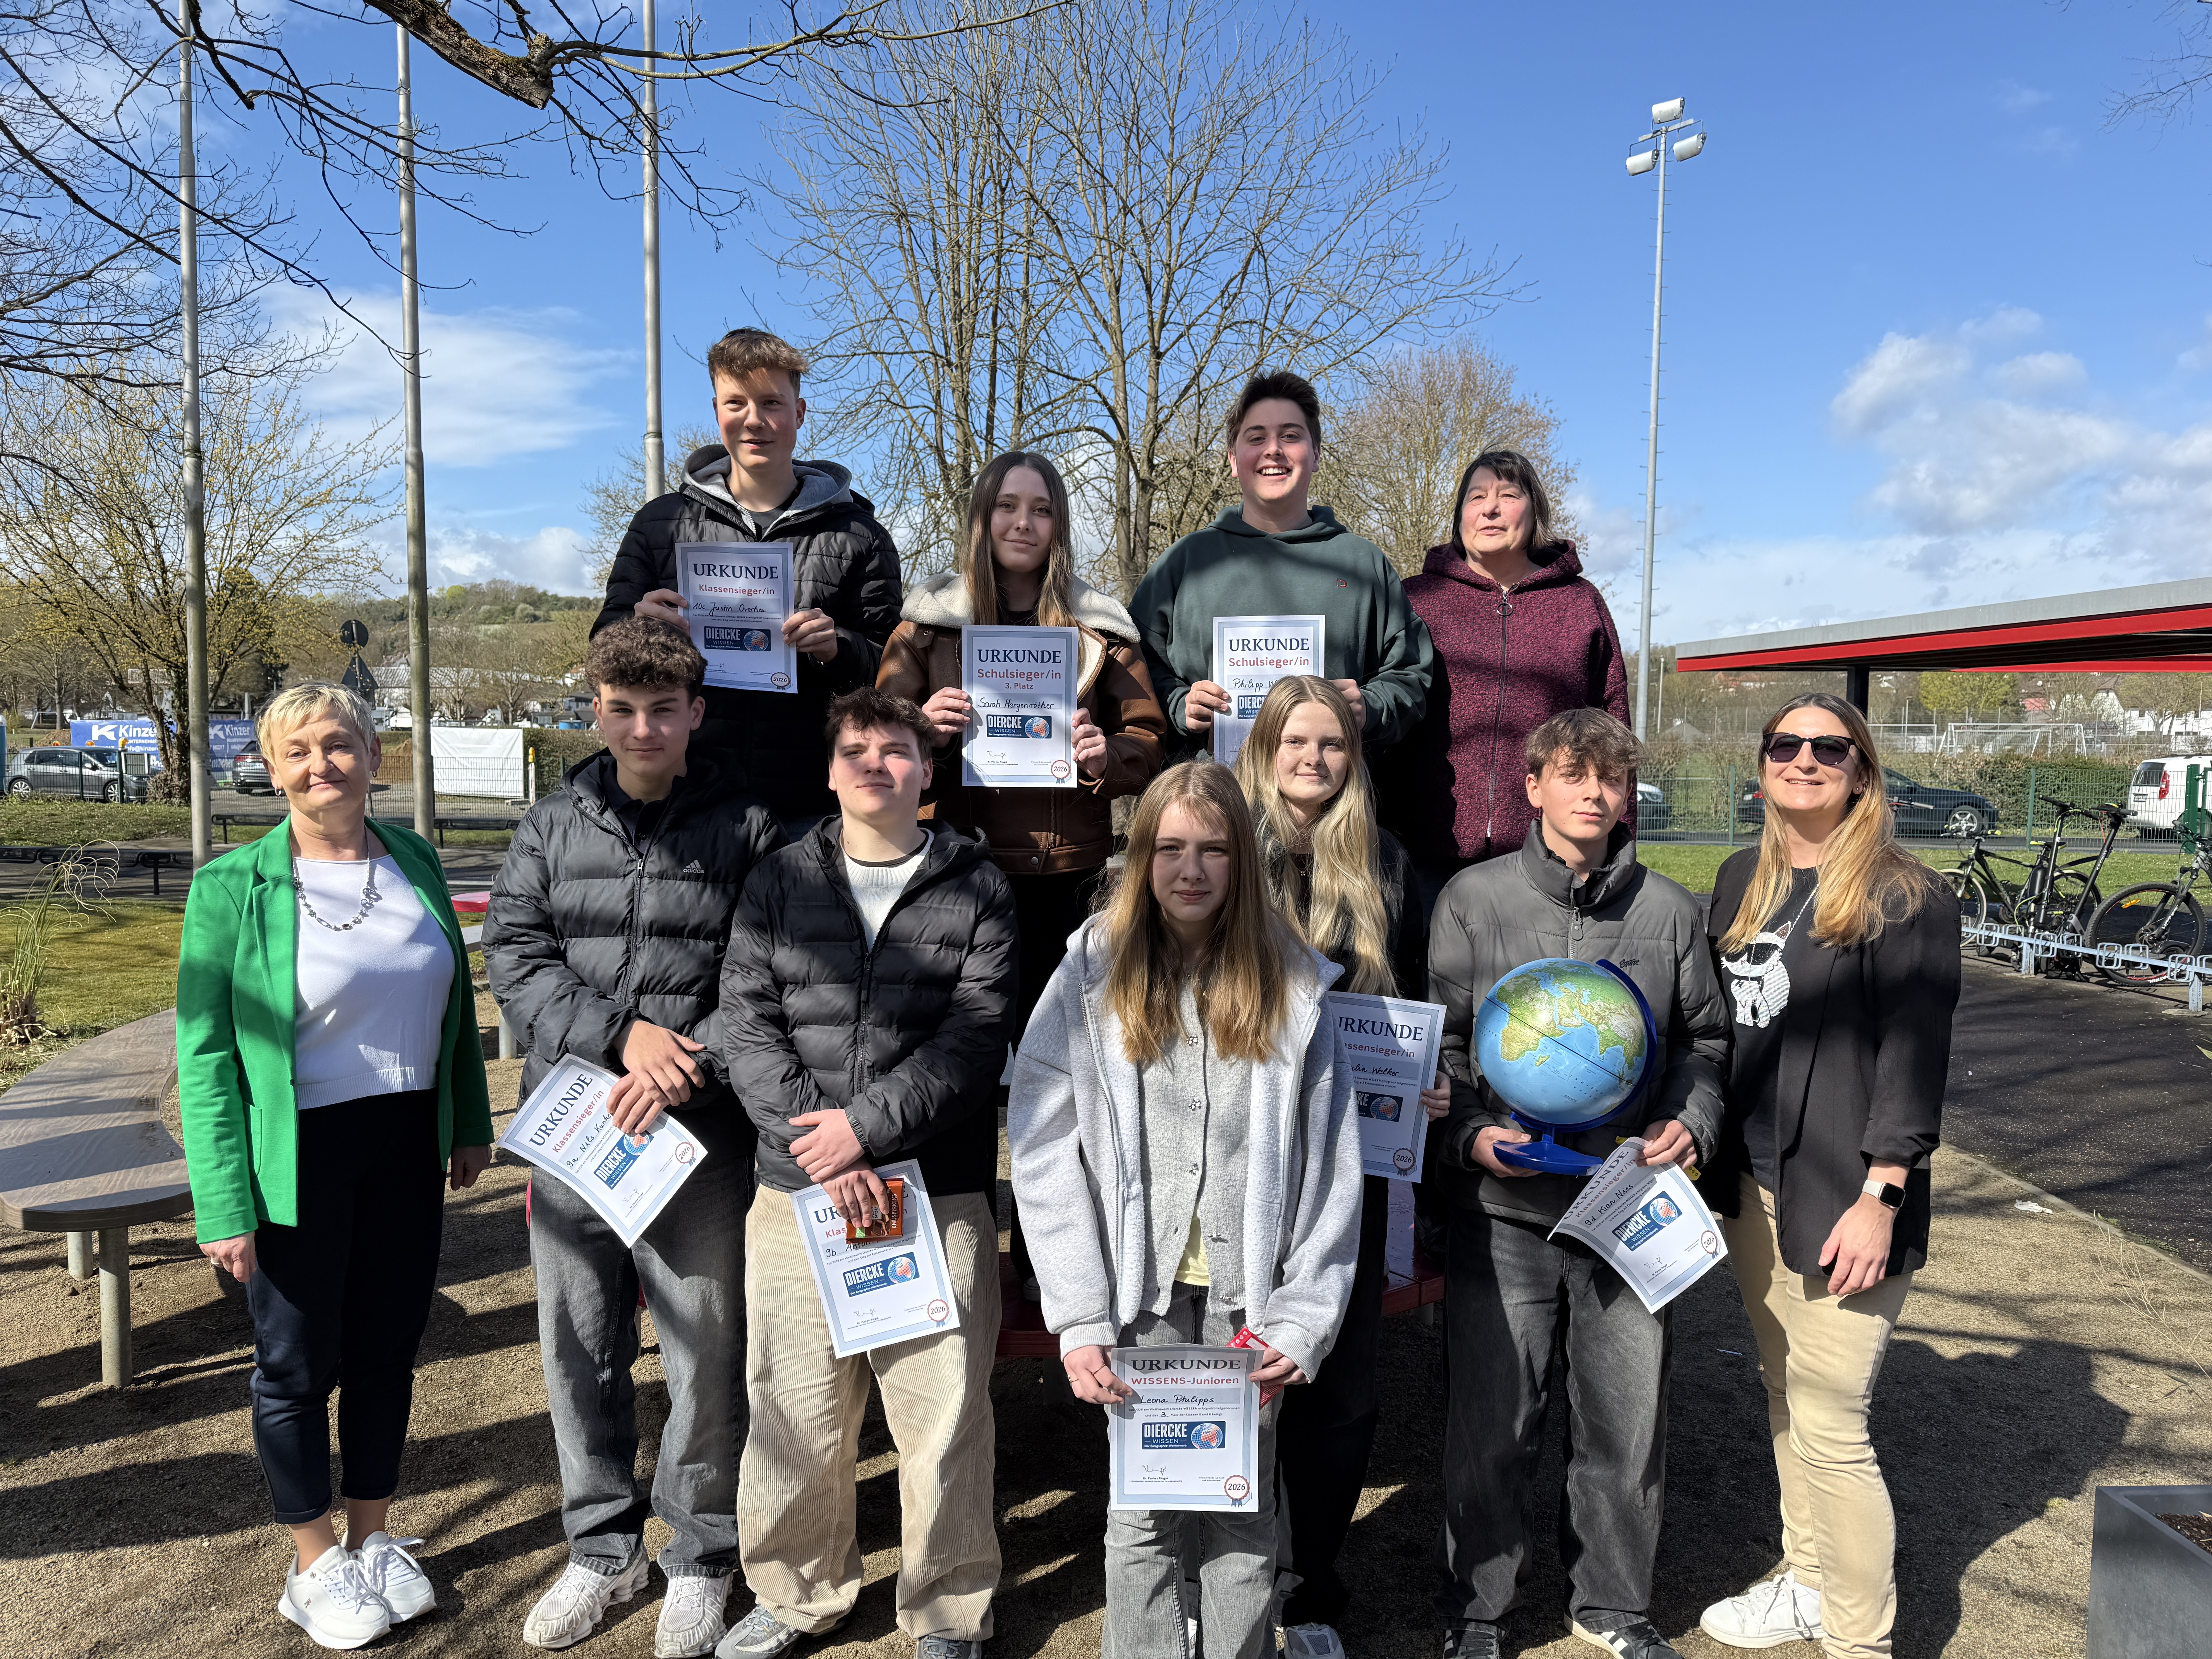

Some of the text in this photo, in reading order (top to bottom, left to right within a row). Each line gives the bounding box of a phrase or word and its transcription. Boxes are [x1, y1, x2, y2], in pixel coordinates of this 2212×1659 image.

[693, 563, 778, 579] URKUNDE
[699, 584, 775, 596] Klassensieger/in
[709, 603, 732, 616] Justin
[706, 627, 740, 640] DIERCKE
[1228, 638, 1309, 651] URKUNDE
[977, 649, 1061, 663] URKUNDE
[1229, 657, 1309, 668] Schulsieger/in
[977, 668, 1061, 681] Schulsieger/in
[1233, 678, 1263, 692] Philipp
[977, 697, 1001, 708] Sarah
[1239, 696, 1266, 709] DIERC
[988, 716, 1022, 728] DIERCKE
[119, 725, 157, 737] Kinze
[224, 724, 250, 736] Kinzer
[1345, 1042, 1415, 1058] ssensieger/in
[1351, 1063, 1367, 1072] ulia
[529, 1073, 593, 1147] URKUNDE
[552, 1090, 604, 1153] Klassensieger/in
[580, 1136, 594, 1152] Nils
[678, 1145, 691, 1161] 2026
[596, 1146, 627, 1182] DIERCKE
[610, 1161, 627, 1180] WISSEN
[1575, 1159, 1636, 1217] Klassensieger/in
[1614, 1211, 1651, 1242] DIERCKE
[1704, 1235, 1715, 1248] 2026
[845, 1263, 885, 1286] DIERCKE
[856, 1279, 879, 1289] WISSEN
[931, 1305, 945, 1315] 2026
[1132, 1359, 1241, 1370] URKUNDE
[1131, 1377, 1239, 1385] WISSENS-Junioren
[1140, 1395, 1214, 1406] Leona Philipps
[1144, 1423, 1187, 1438] DIERCKE
